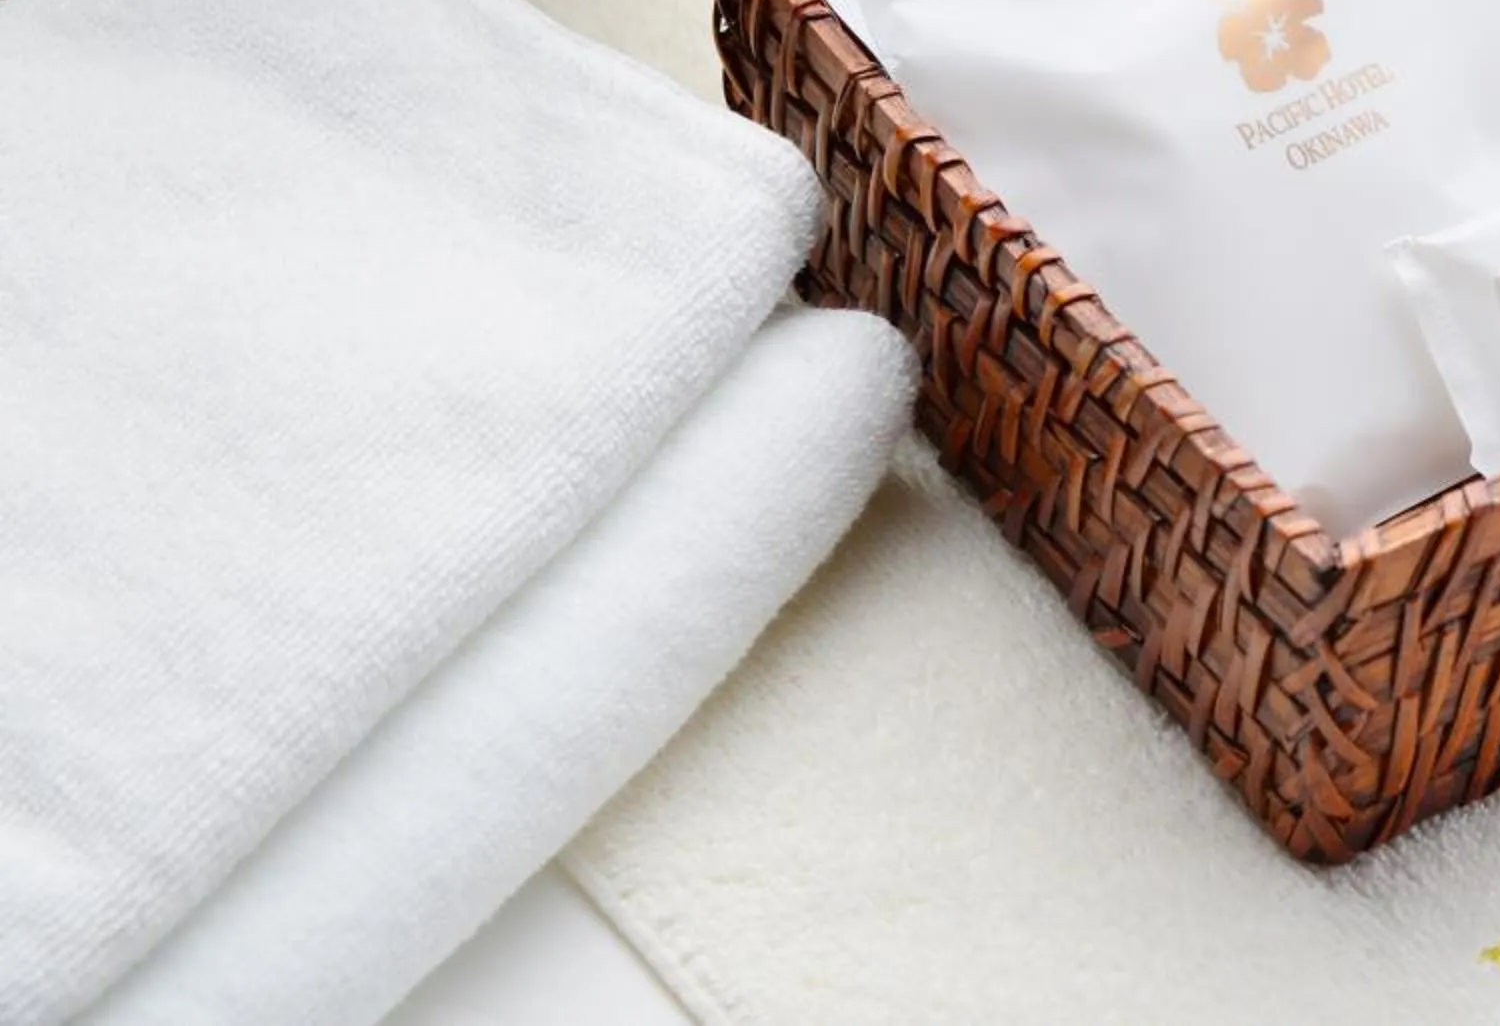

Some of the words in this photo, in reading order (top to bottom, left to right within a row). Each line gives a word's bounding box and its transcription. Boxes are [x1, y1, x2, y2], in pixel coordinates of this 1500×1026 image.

[1235, 92, 1326, 151] PACIFIC
[1317, 63, 1397, 110] HOTEL
[1285, 110, 1390, 170] OKINAWA
